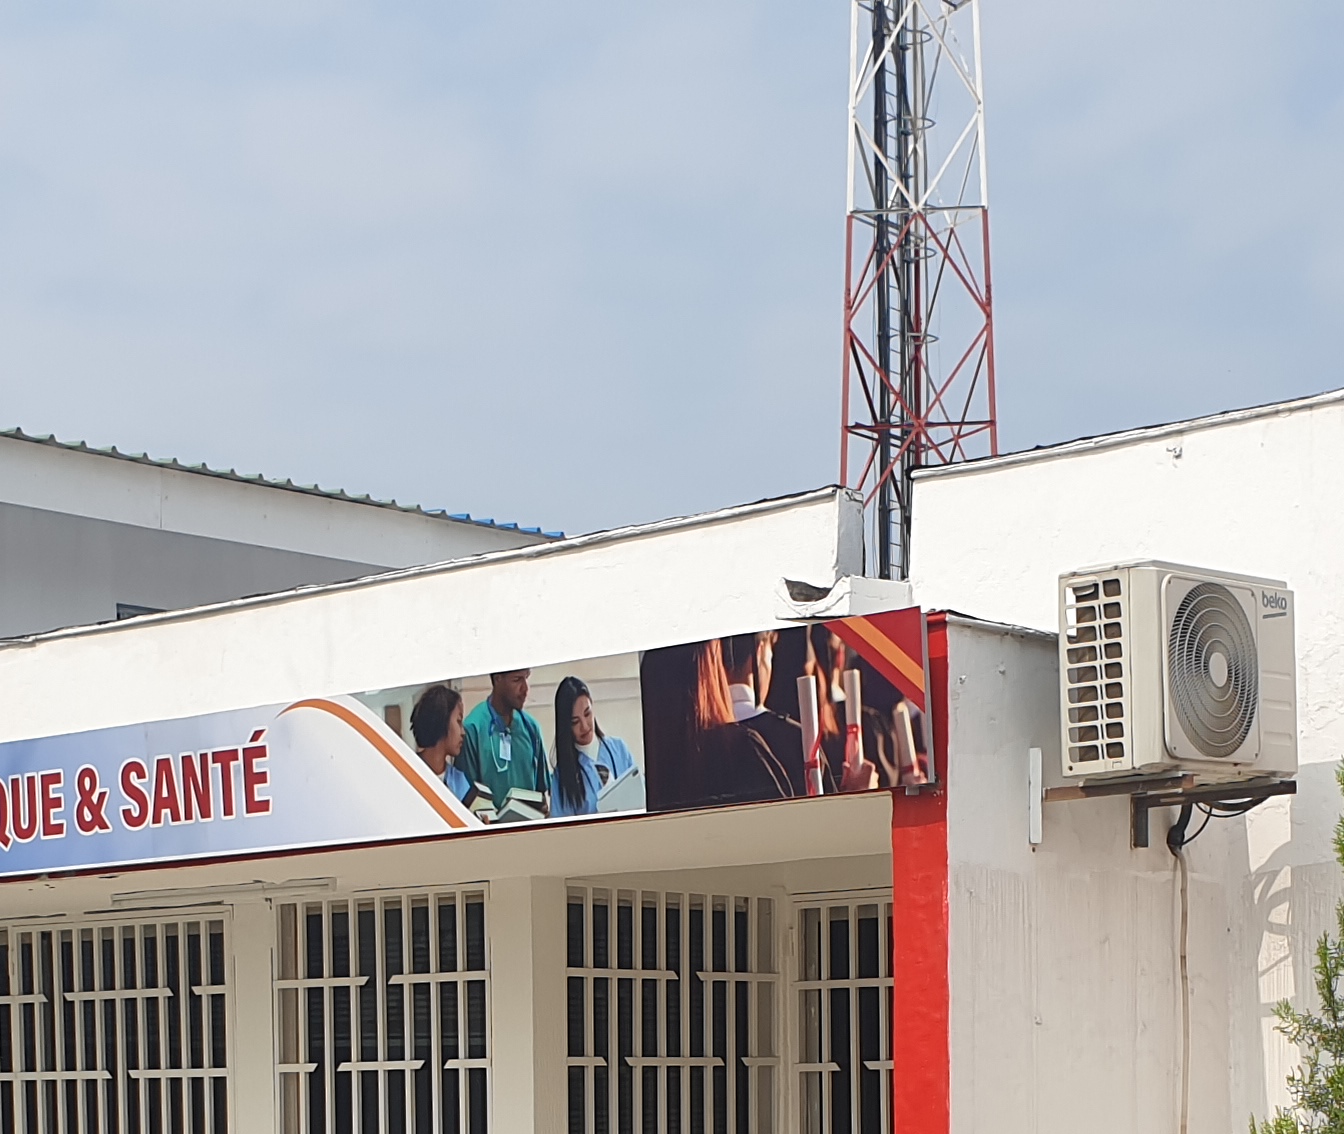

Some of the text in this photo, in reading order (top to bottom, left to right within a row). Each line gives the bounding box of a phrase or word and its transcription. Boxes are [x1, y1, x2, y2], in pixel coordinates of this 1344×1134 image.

[1262, 590, 1287, 610] beko
[74, 763, 112, 835] &
[120, 726, 272, 833] SANTÉ
